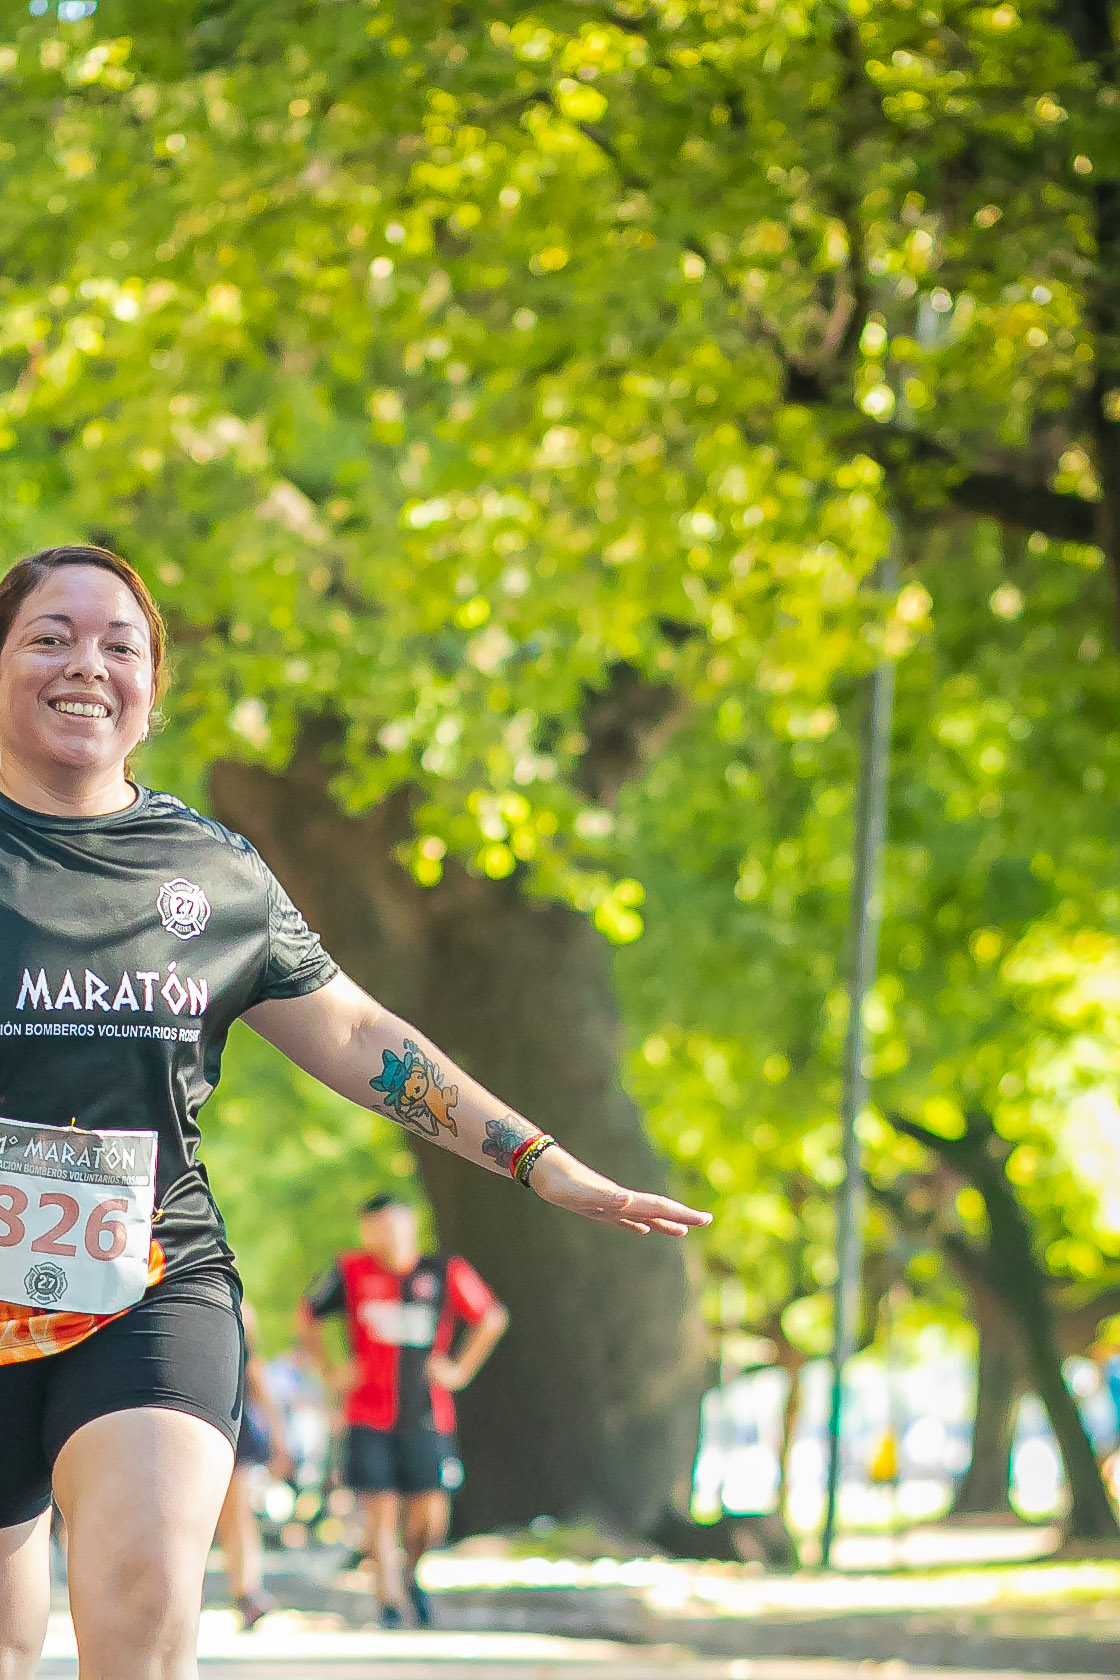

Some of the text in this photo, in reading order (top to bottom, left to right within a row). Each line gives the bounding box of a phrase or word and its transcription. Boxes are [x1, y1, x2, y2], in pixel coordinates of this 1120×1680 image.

[15, 960, 209, 1017] MARATÓN
[24, 1023, 95, 1037] BOMBEROS
[97, 1025, 178, 1041] VOLUNTARIOS
[23, 1140, 136, 1170] MARATÓN
[23, 1163, 69, 1180] BOMBEROS
[69, 1170, 120, 1185] VOLUNTARIOS
